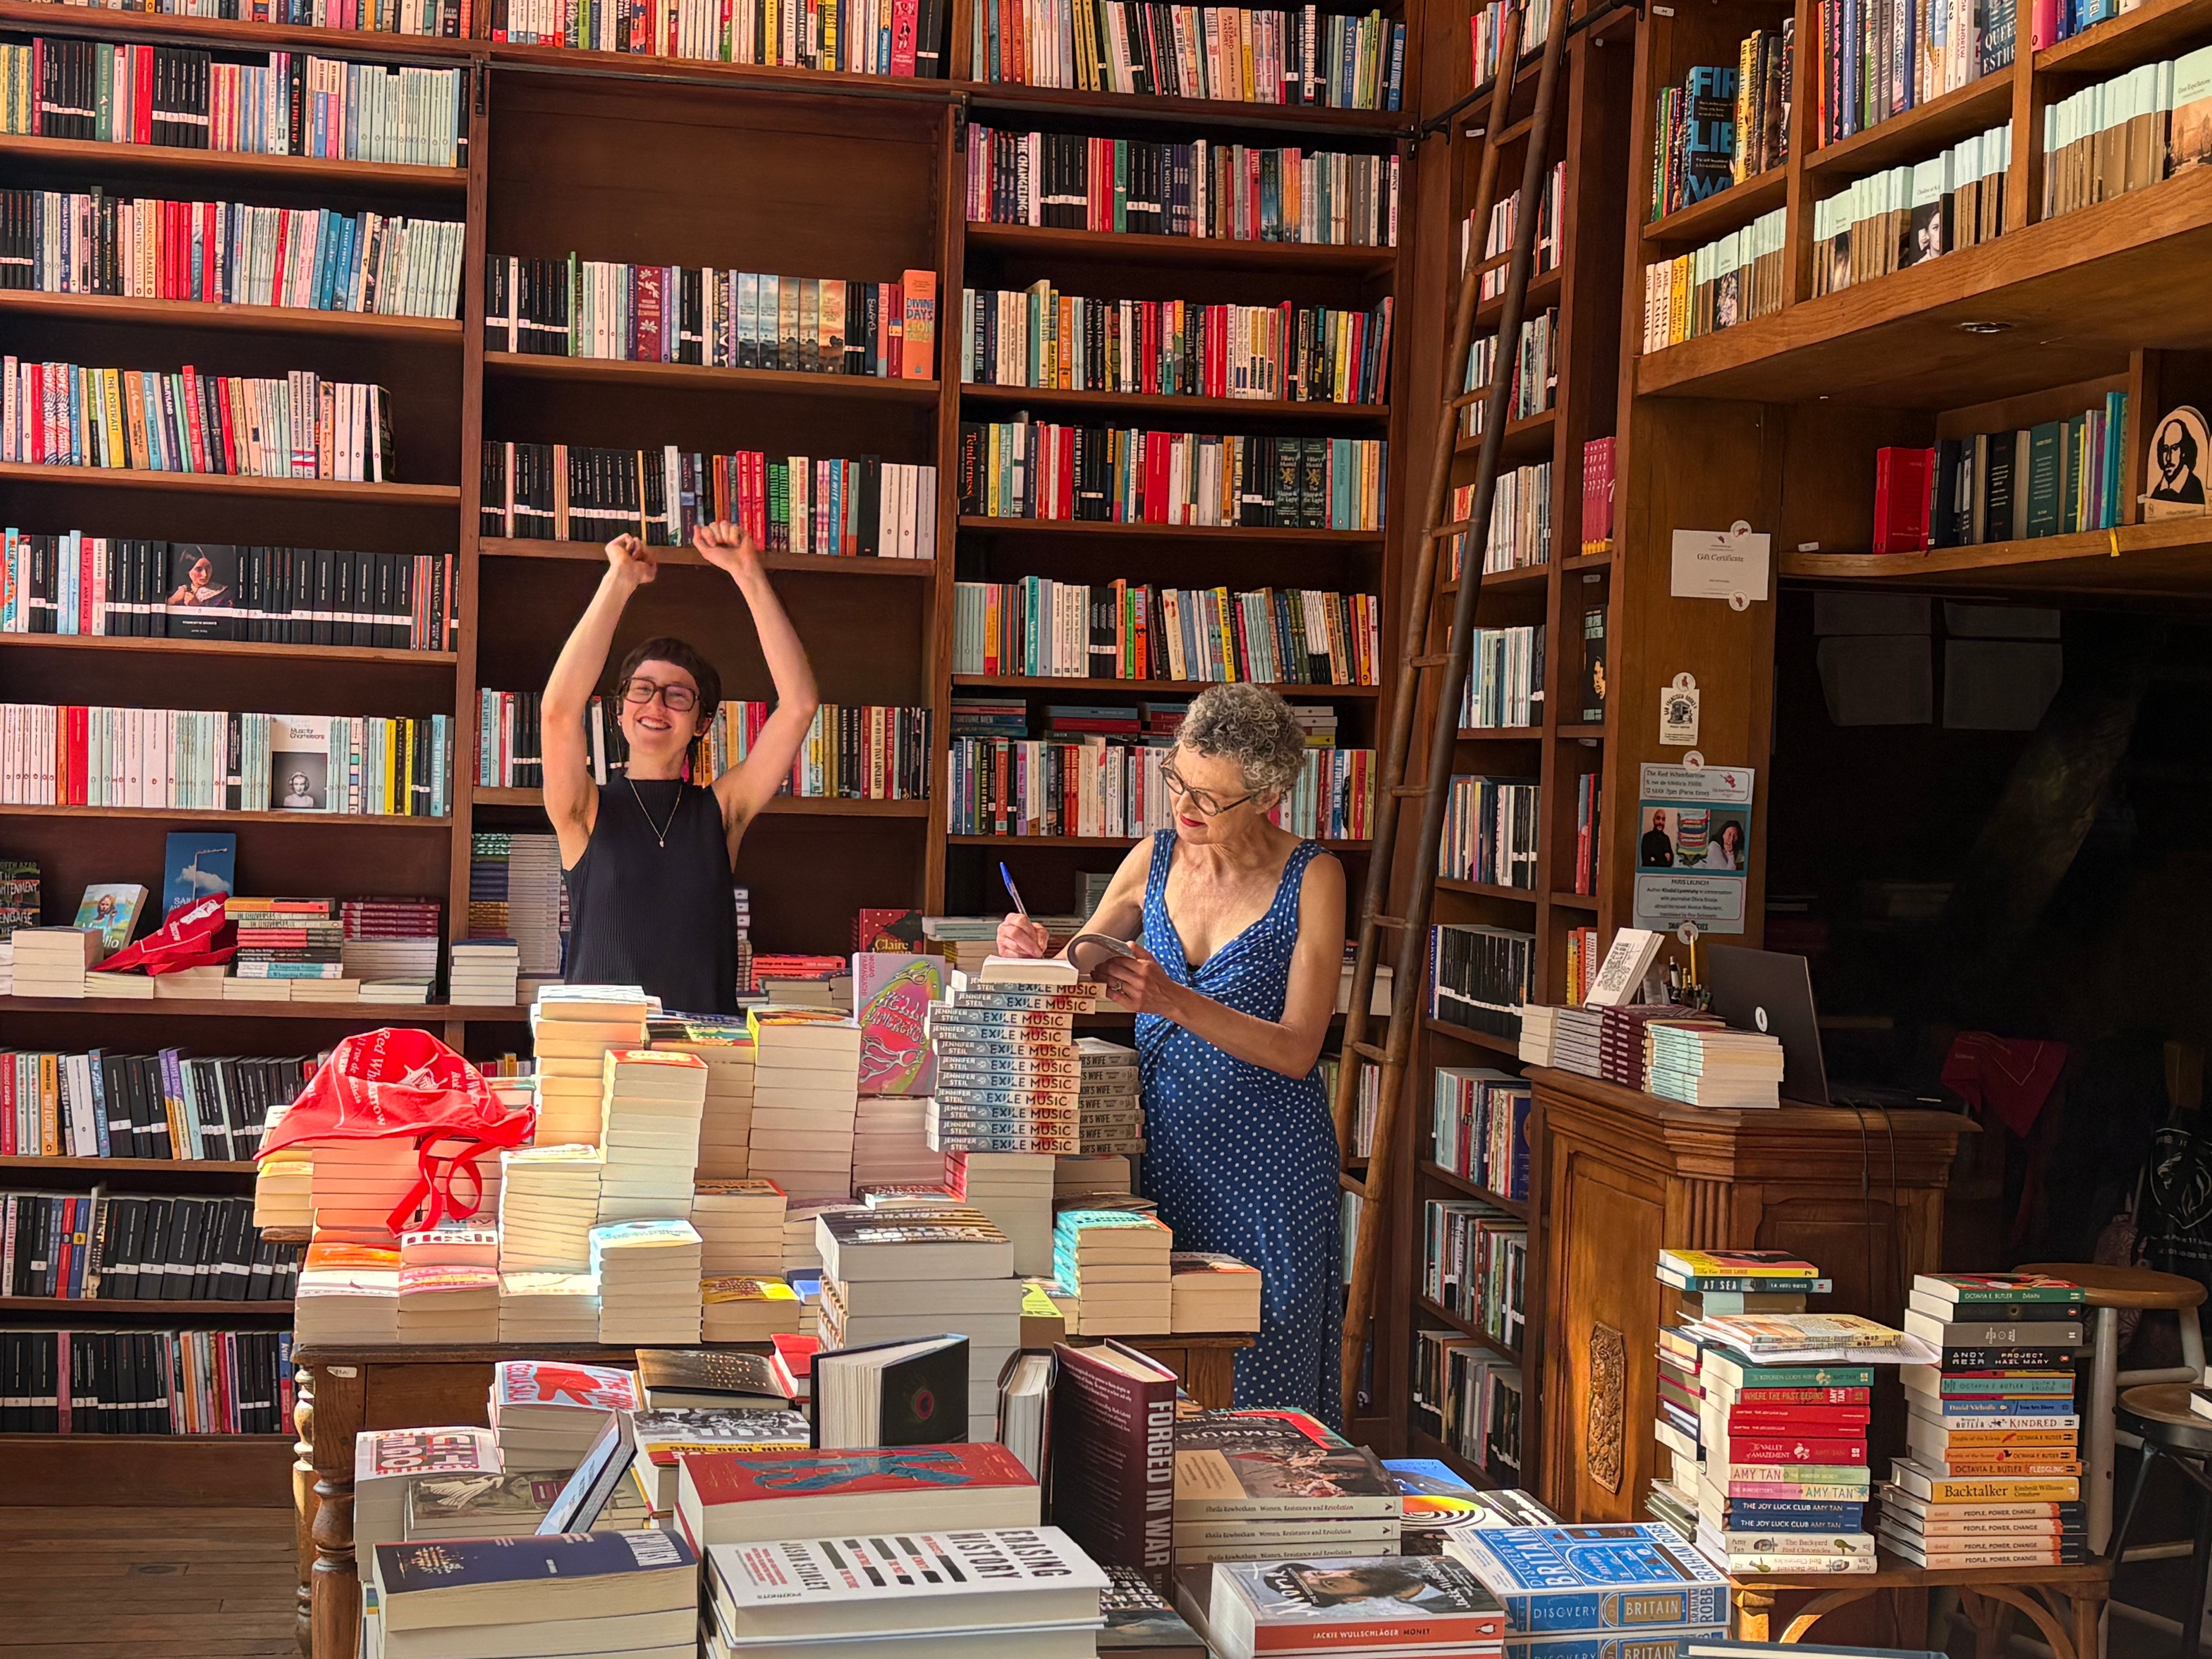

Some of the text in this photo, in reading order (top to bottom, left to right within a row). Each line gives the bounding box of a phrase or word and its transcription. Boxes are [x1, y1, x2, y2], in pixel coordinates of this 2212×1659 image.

[1345, 25, 1355, 62] Stolen
[1017, 136, 1028, 211] THE CHANGELING
[907, 298, 934, 308] DIVINE
[907, 309, 933, 321] DAYS
[110, 393, 118, 432] PORTRAIT
[967, 433, 977, 495] Tenderness
[770, 464, 779, 521] UNSETTLED GROUND
[780, 465, 788, 522] UNSETTLED GROUND
[875, 939, 909, 950] Claire
[1018, 984, 1097, 995] EXILE MUSIC
[1007, 997, 1087, 1011] EXILE MUSIC
[983, 1012, 1063, 1026] EXILE MUSIC
[981, 1029, 1061, 1042] EXILE MUSIC
[353, 1047, 361, 1062] rue
[990, 1044, 1070, 1057] EXILE MUSIC
[991, 1060, 1072, 1073] EXILE MUSIC
[1092, 1056, 1106, 1064] WIFE
[350, 1064, 359, 1073] de
[1089, 1072, 1103, 1080] WIFE
[1703, 1281, 1736, 1290] AT SEA
[1745, 1391, 1824, 1400] WHERE THE PAST BEGINS
[1838, 1389, 1846, 1402] TAN
[2009, 1419, 2057, 1428] KINDRED
[1733, 1469, 1756, 1480] AMY
[1760, 1470, 1781, 1480] TAN
[1144, 1400, 1174, 1567] FORGED IN WAR
[1806, 1487, 1853, 1498] AMY TAN
[1945, 1485, 2008, 1497] Backtalker
[1653, 1524, 1682, 1546] ROBB
[946, 1532, 1024, 1580] HISTORY
[994, 1530, 1073, 1578] ERASING
[1499, 1529, 1580, 1585] BRITAIN
[779, 1542, 807, 1562] JASON
[794, 1562, 832, 1591] STANLEY
[1499, 1545, 1545, 1587] DISCOVERY
[1678, 1546, 1721, 1582] GRAHAM
[1534, 1606, 1598, 1619] DISCOVERY
[1626, 1600, 1679, 1615] BRITAIN
[1691, 1589, 1700, 1623] GRAHAM
[1700, 1587, 1714, 1622] ROBB
[1313, 1632, 1338, 1640] JACKIE
[1340, 1629, 1399, 1639] WULLSCHLÄGER
[1625, 1645, 1677, 1659] BRITAIN
